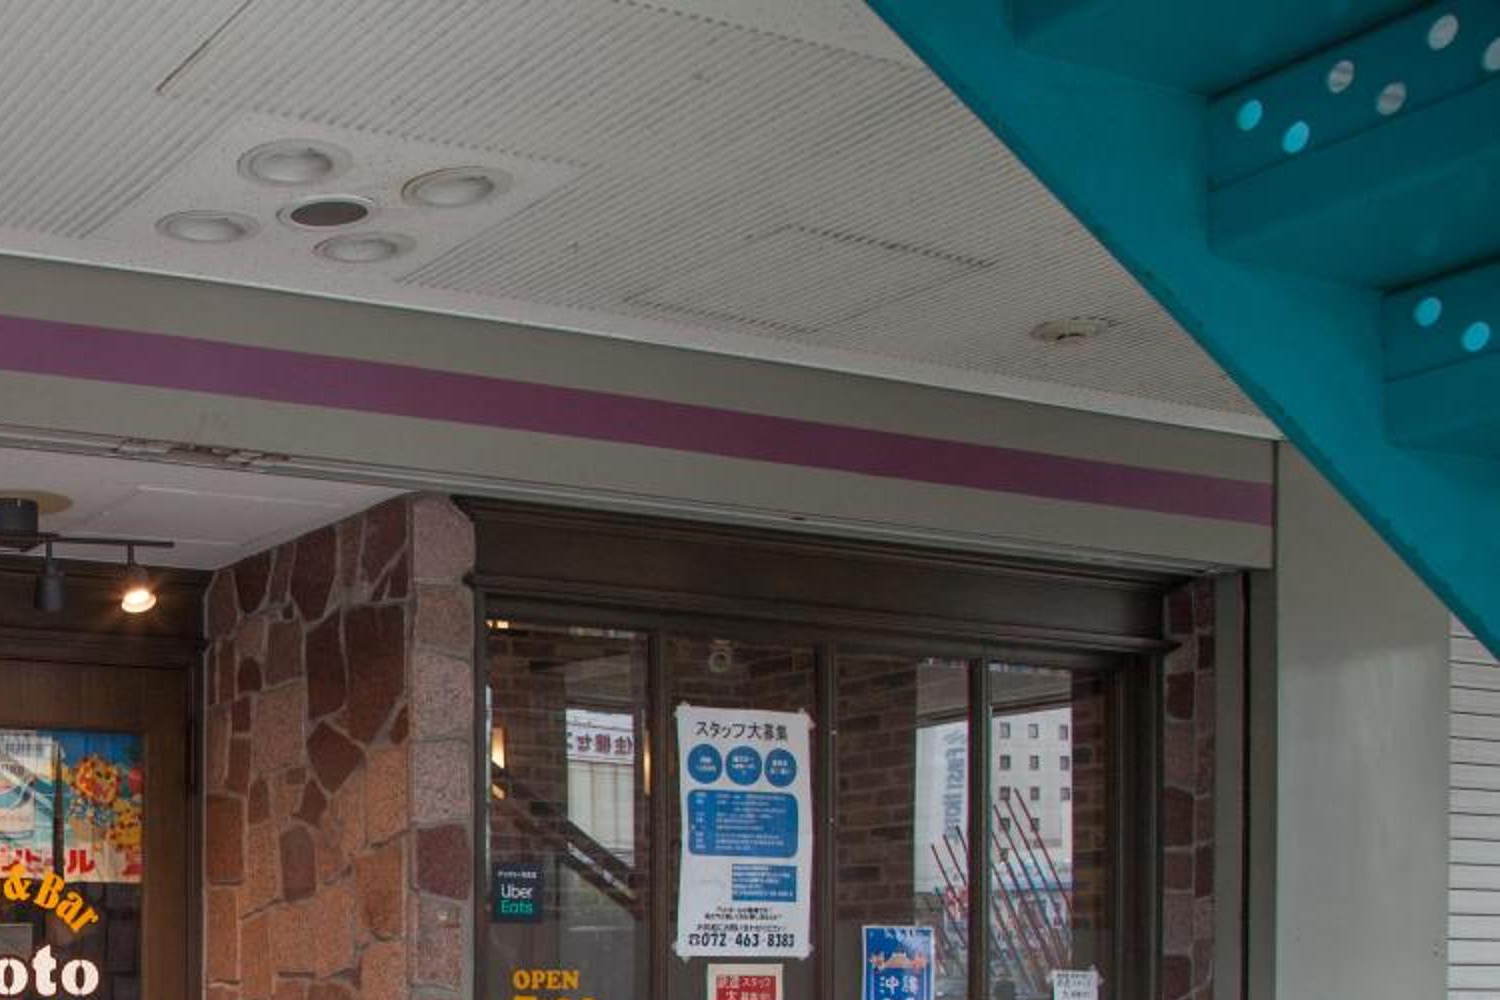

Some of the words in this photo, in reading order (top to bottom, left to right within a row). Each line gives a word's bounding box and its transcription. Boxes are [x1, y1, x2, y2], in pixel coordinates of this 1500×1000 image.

[33, 868, 99, 933] Bar
[500, 883, 534, 899] Uber
[500, 899, 534, 914] Eats
[512, 968, 581, 990] OPEN
